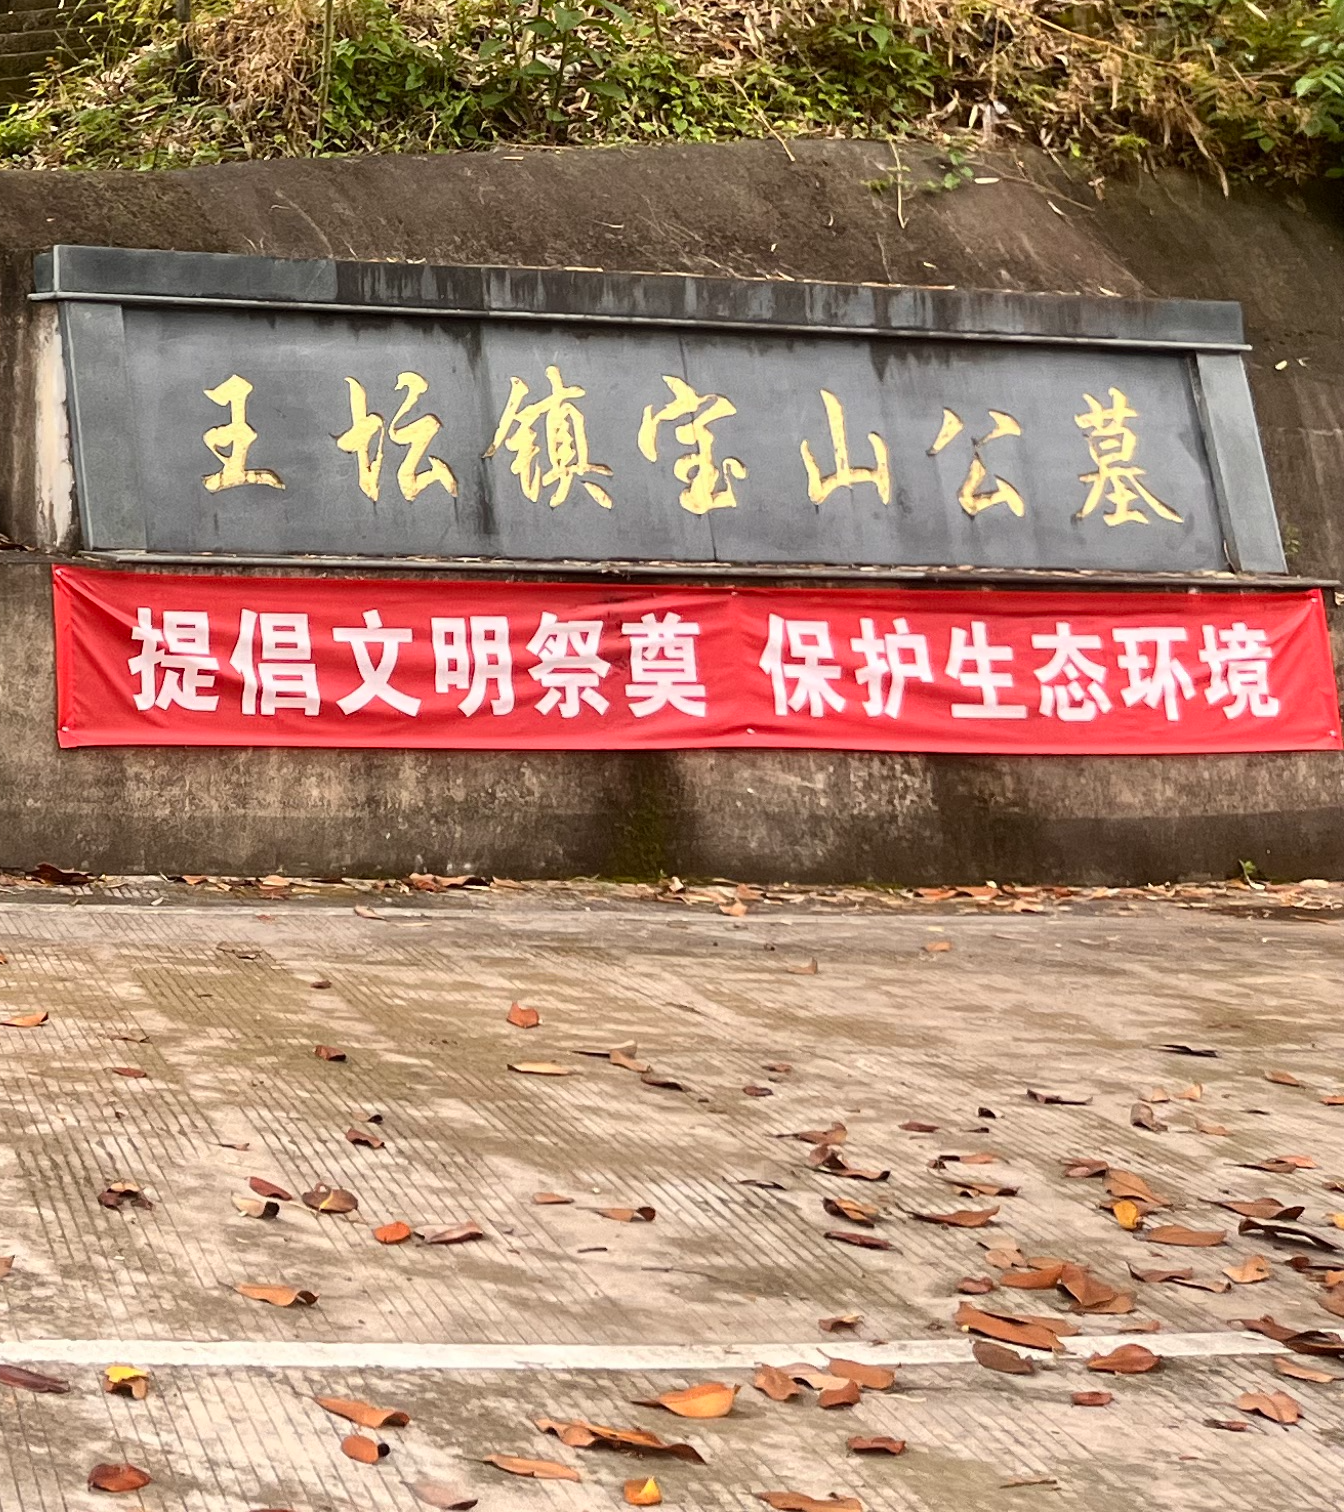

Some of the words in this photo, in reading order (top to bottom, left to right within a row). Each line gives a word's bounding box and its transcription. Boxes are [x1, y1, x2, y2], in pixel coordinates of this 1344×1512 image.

[203, 366, 1184, 526] 王坛镇宝山公墓
[130, 608, 706, 718] 提倡文明祭奠
[759, 612, 1280, 722] 保护生态环境
